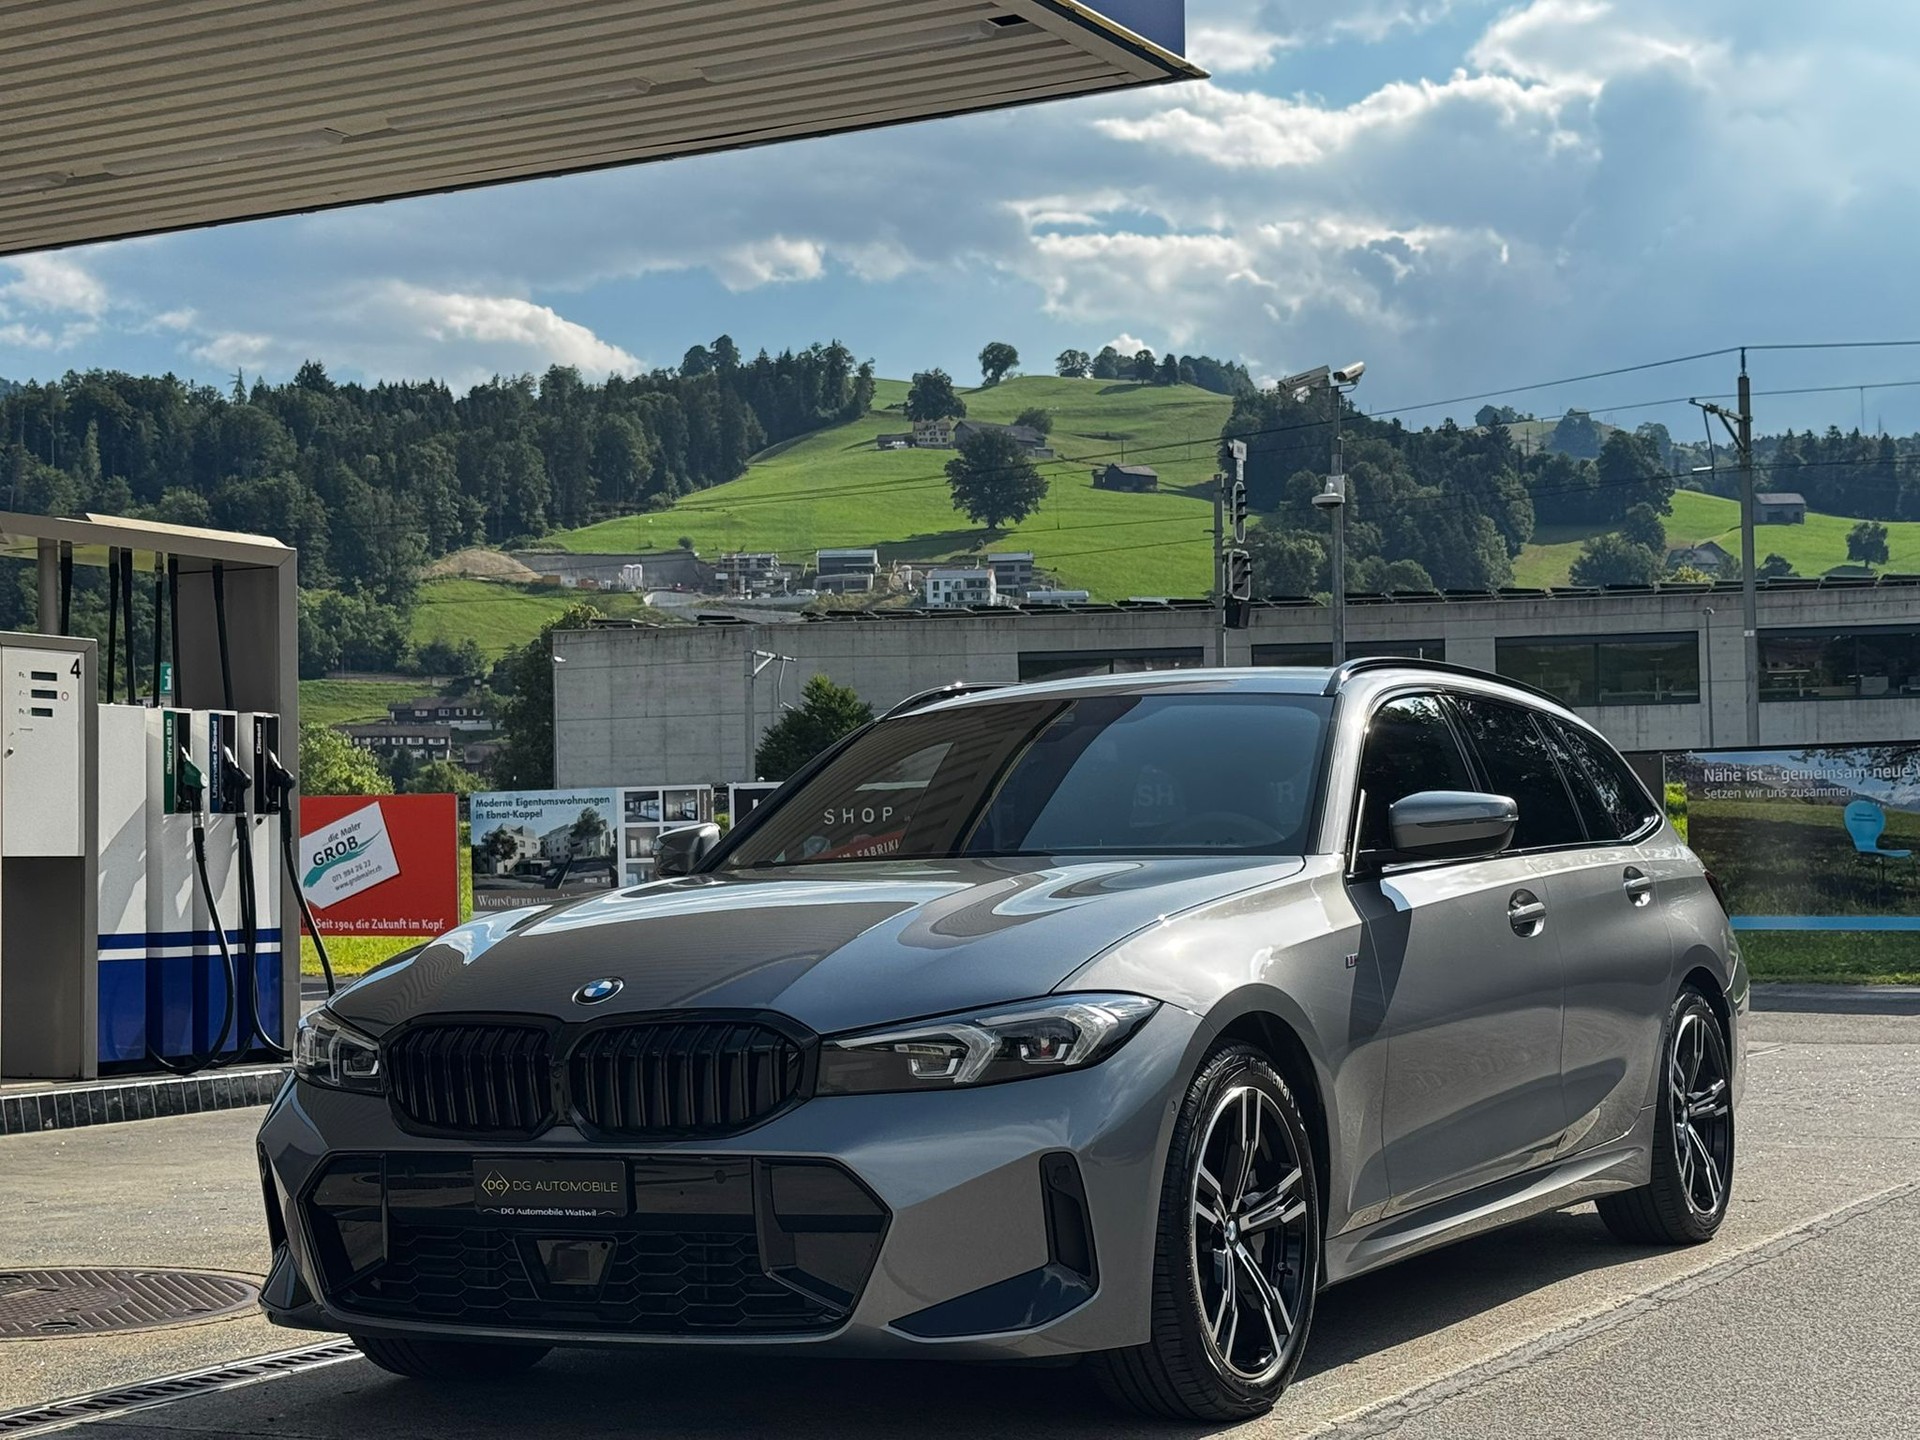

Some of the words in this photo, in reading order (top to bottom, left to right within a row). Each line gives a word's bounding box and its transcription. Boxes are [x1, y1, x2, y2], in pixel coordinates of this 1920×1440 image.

[70, 658, 81, 679] 4
[1704, 768, 1741, 782] Nähe
[1781, 767, 1867, 783] gemeinsam
[1872, 766, 1909, 778] neue
[1704, 787, 1741, 800] Setzen
[1745, 787, 1763, 798] wir
[1767, 788, 1787, 798] uns
[1790, 786, 1857, 798] zusammen.
[475, 798, 513, 808] Moderne
[516, 795, 610, 808] Eigentumswohnungen
[475, 810, 484, 819] in
[486, 809, 543, 820] Ebnat-Kappel
[823, 806, 893, 825] SHOP
[340, 822, 362, 838] Maler
[312, 835, 359, 867] GROB
[315, 918, 333, 929] Seit
[355, 918, 370, 929] die
[371, 918, 407, 929] Zukunft
[408, 918, 421, 929] im
[487, 1179, 504, 1191] DG
[512, 1180, 532, 1191] DG
[535, 1180, 619, 1193] AUTOMOBILE
[500, 1207, 515, 1215] DG
[516, 1207, 564, 1217] Automobile
[565, 1208, 597, 1217] Wattwil
